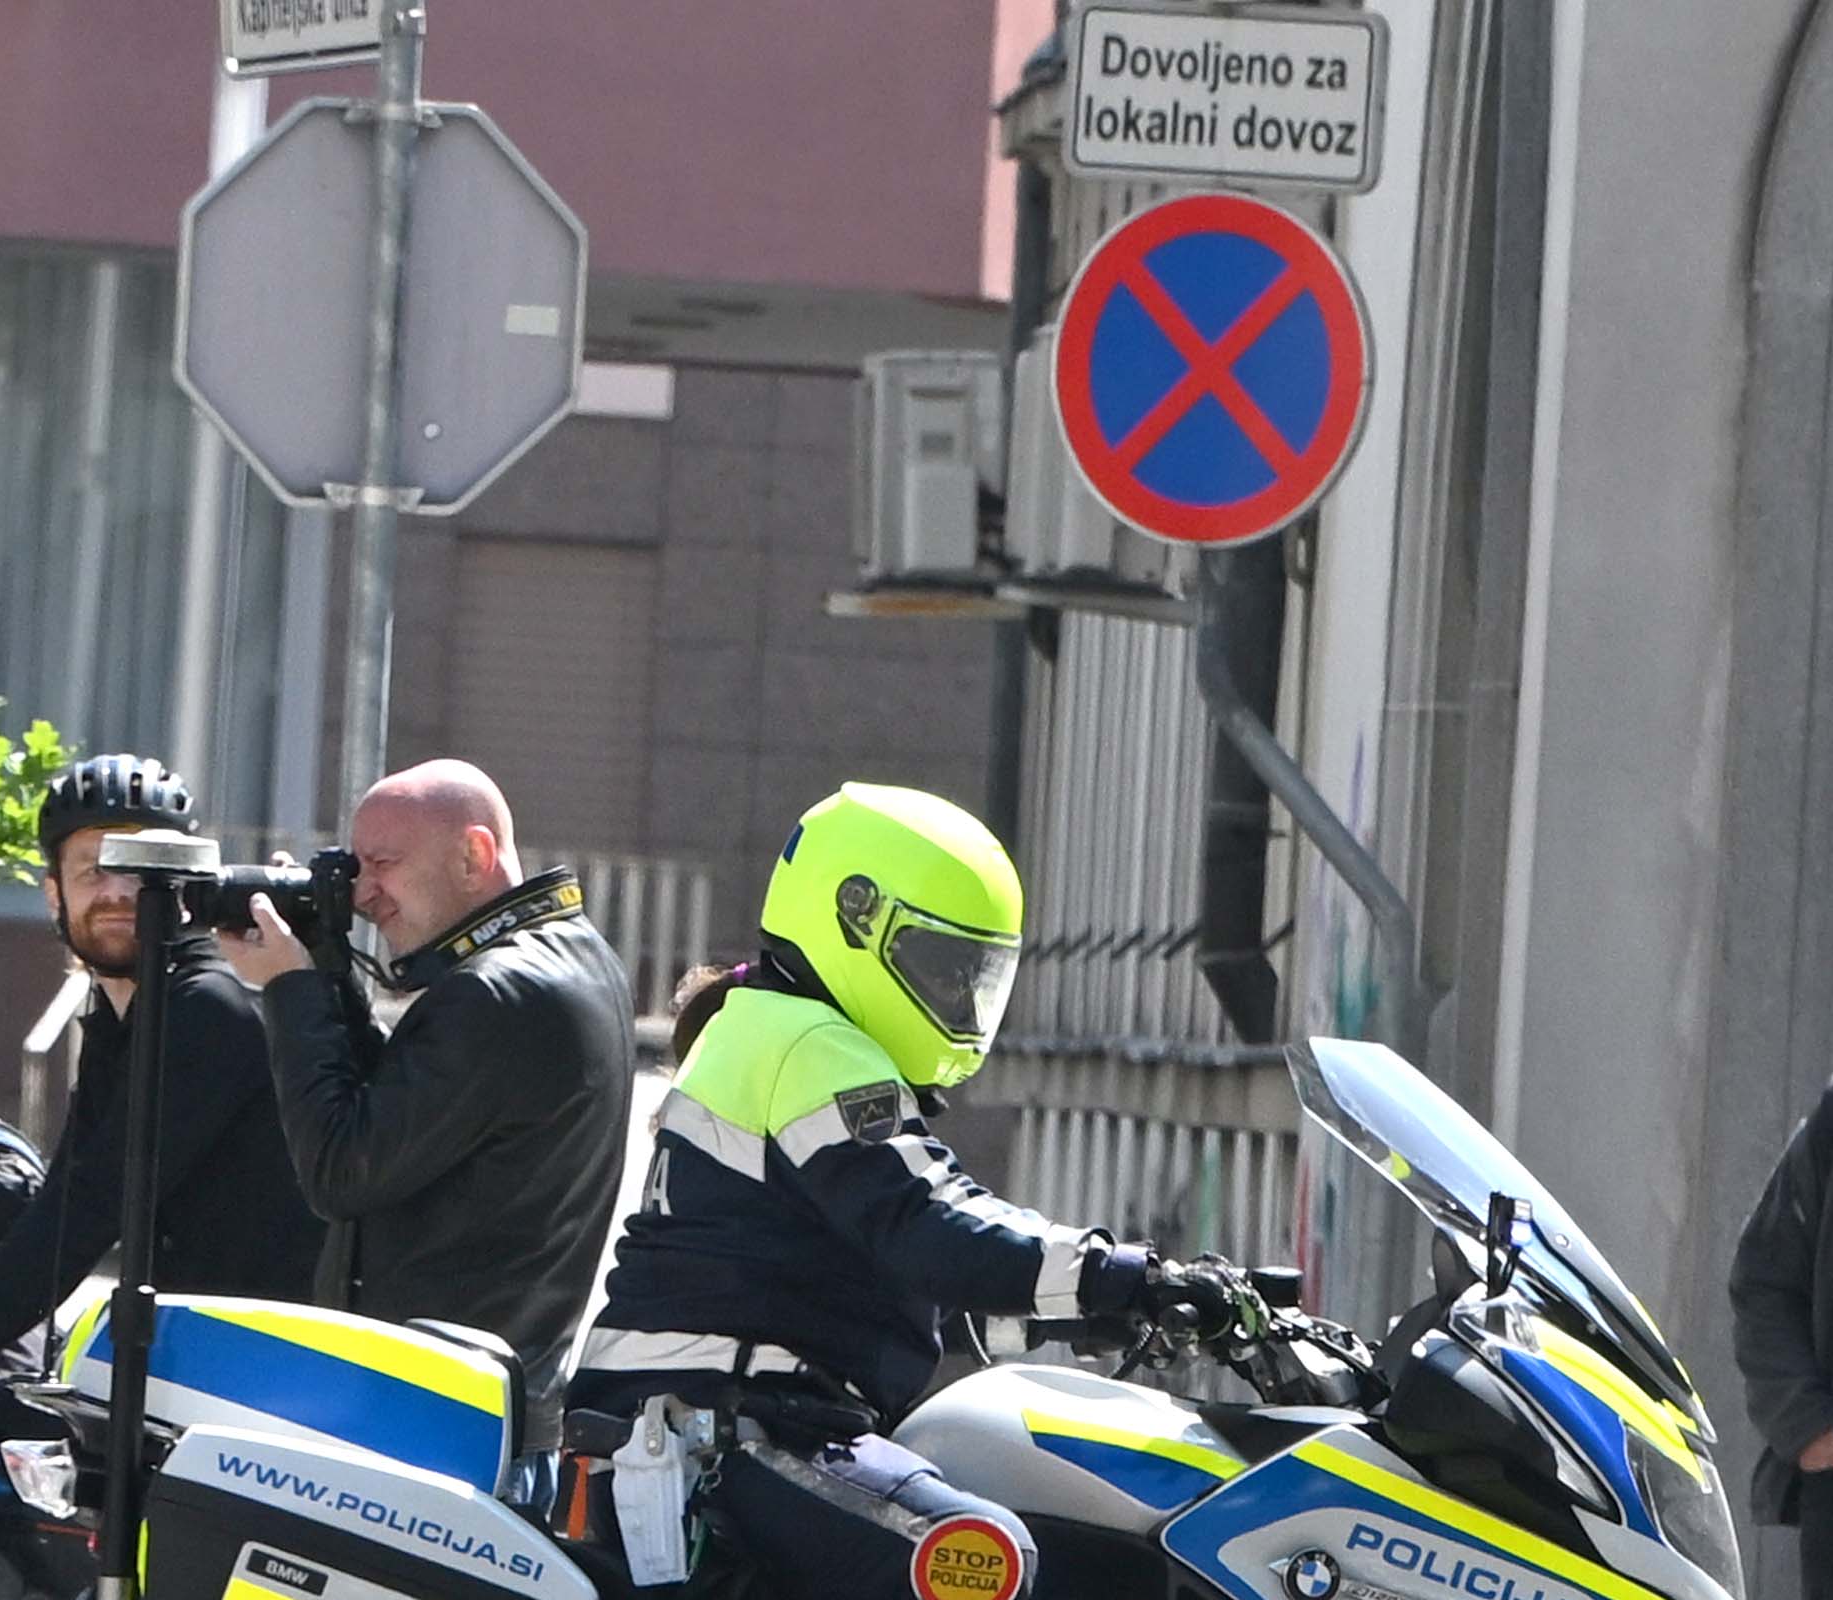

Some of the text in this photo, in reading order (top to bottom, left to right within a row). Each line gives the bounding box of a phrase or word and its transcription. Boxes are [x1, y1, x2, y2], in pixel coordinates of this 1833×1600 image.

[1100, 34, 1348, 94] Dovoljeno za
[1083, 95, 1357, 156] lokalni dovoz
[471, 909, 518, 946] NPS
[217, 1452, 546, 1582] WWW.POLICIJA.SI
[265, 1560, 310, 1586] BMW
[934, 1547, 1004, 1570] STOP
[929, 1569, 1000, 1592] POLICIJA
